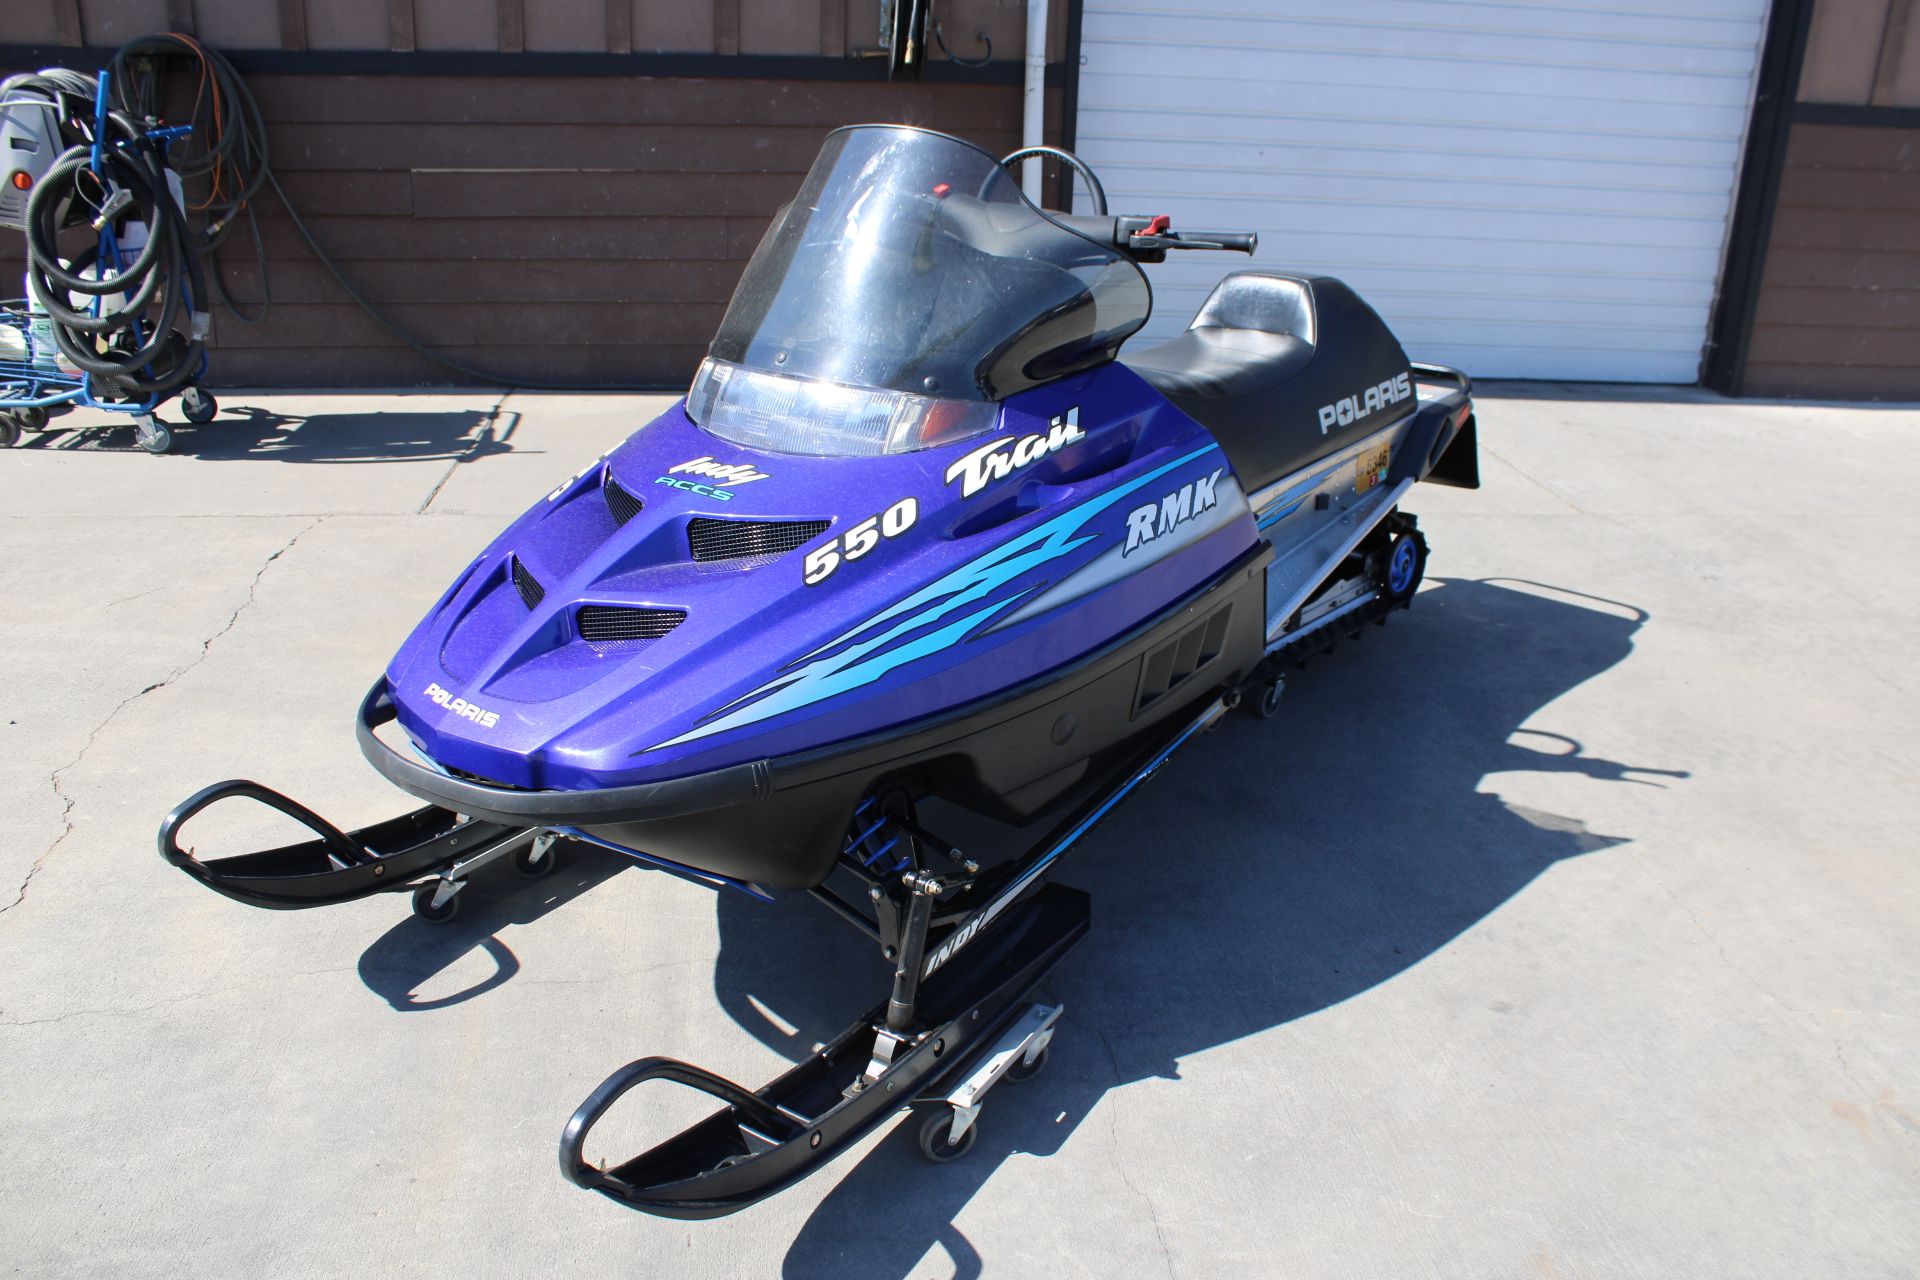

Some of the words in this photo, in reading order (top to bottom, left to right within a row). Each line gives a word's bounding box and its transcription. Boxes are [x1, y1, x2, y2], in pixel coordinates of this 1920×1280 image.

[1318, 371, 1412, 435] POLARIS
[668, 456, 770, 487] Indy
[945, 406, 1087, 499] Trail
[654, 477, 735, 501] ACCS
[1124, 468, 1222, 557] RMK
[803, 497, 918, 586] 550
[423, 682, 501, 729] POLARIS
[924, 911, 985, 978] INDY
